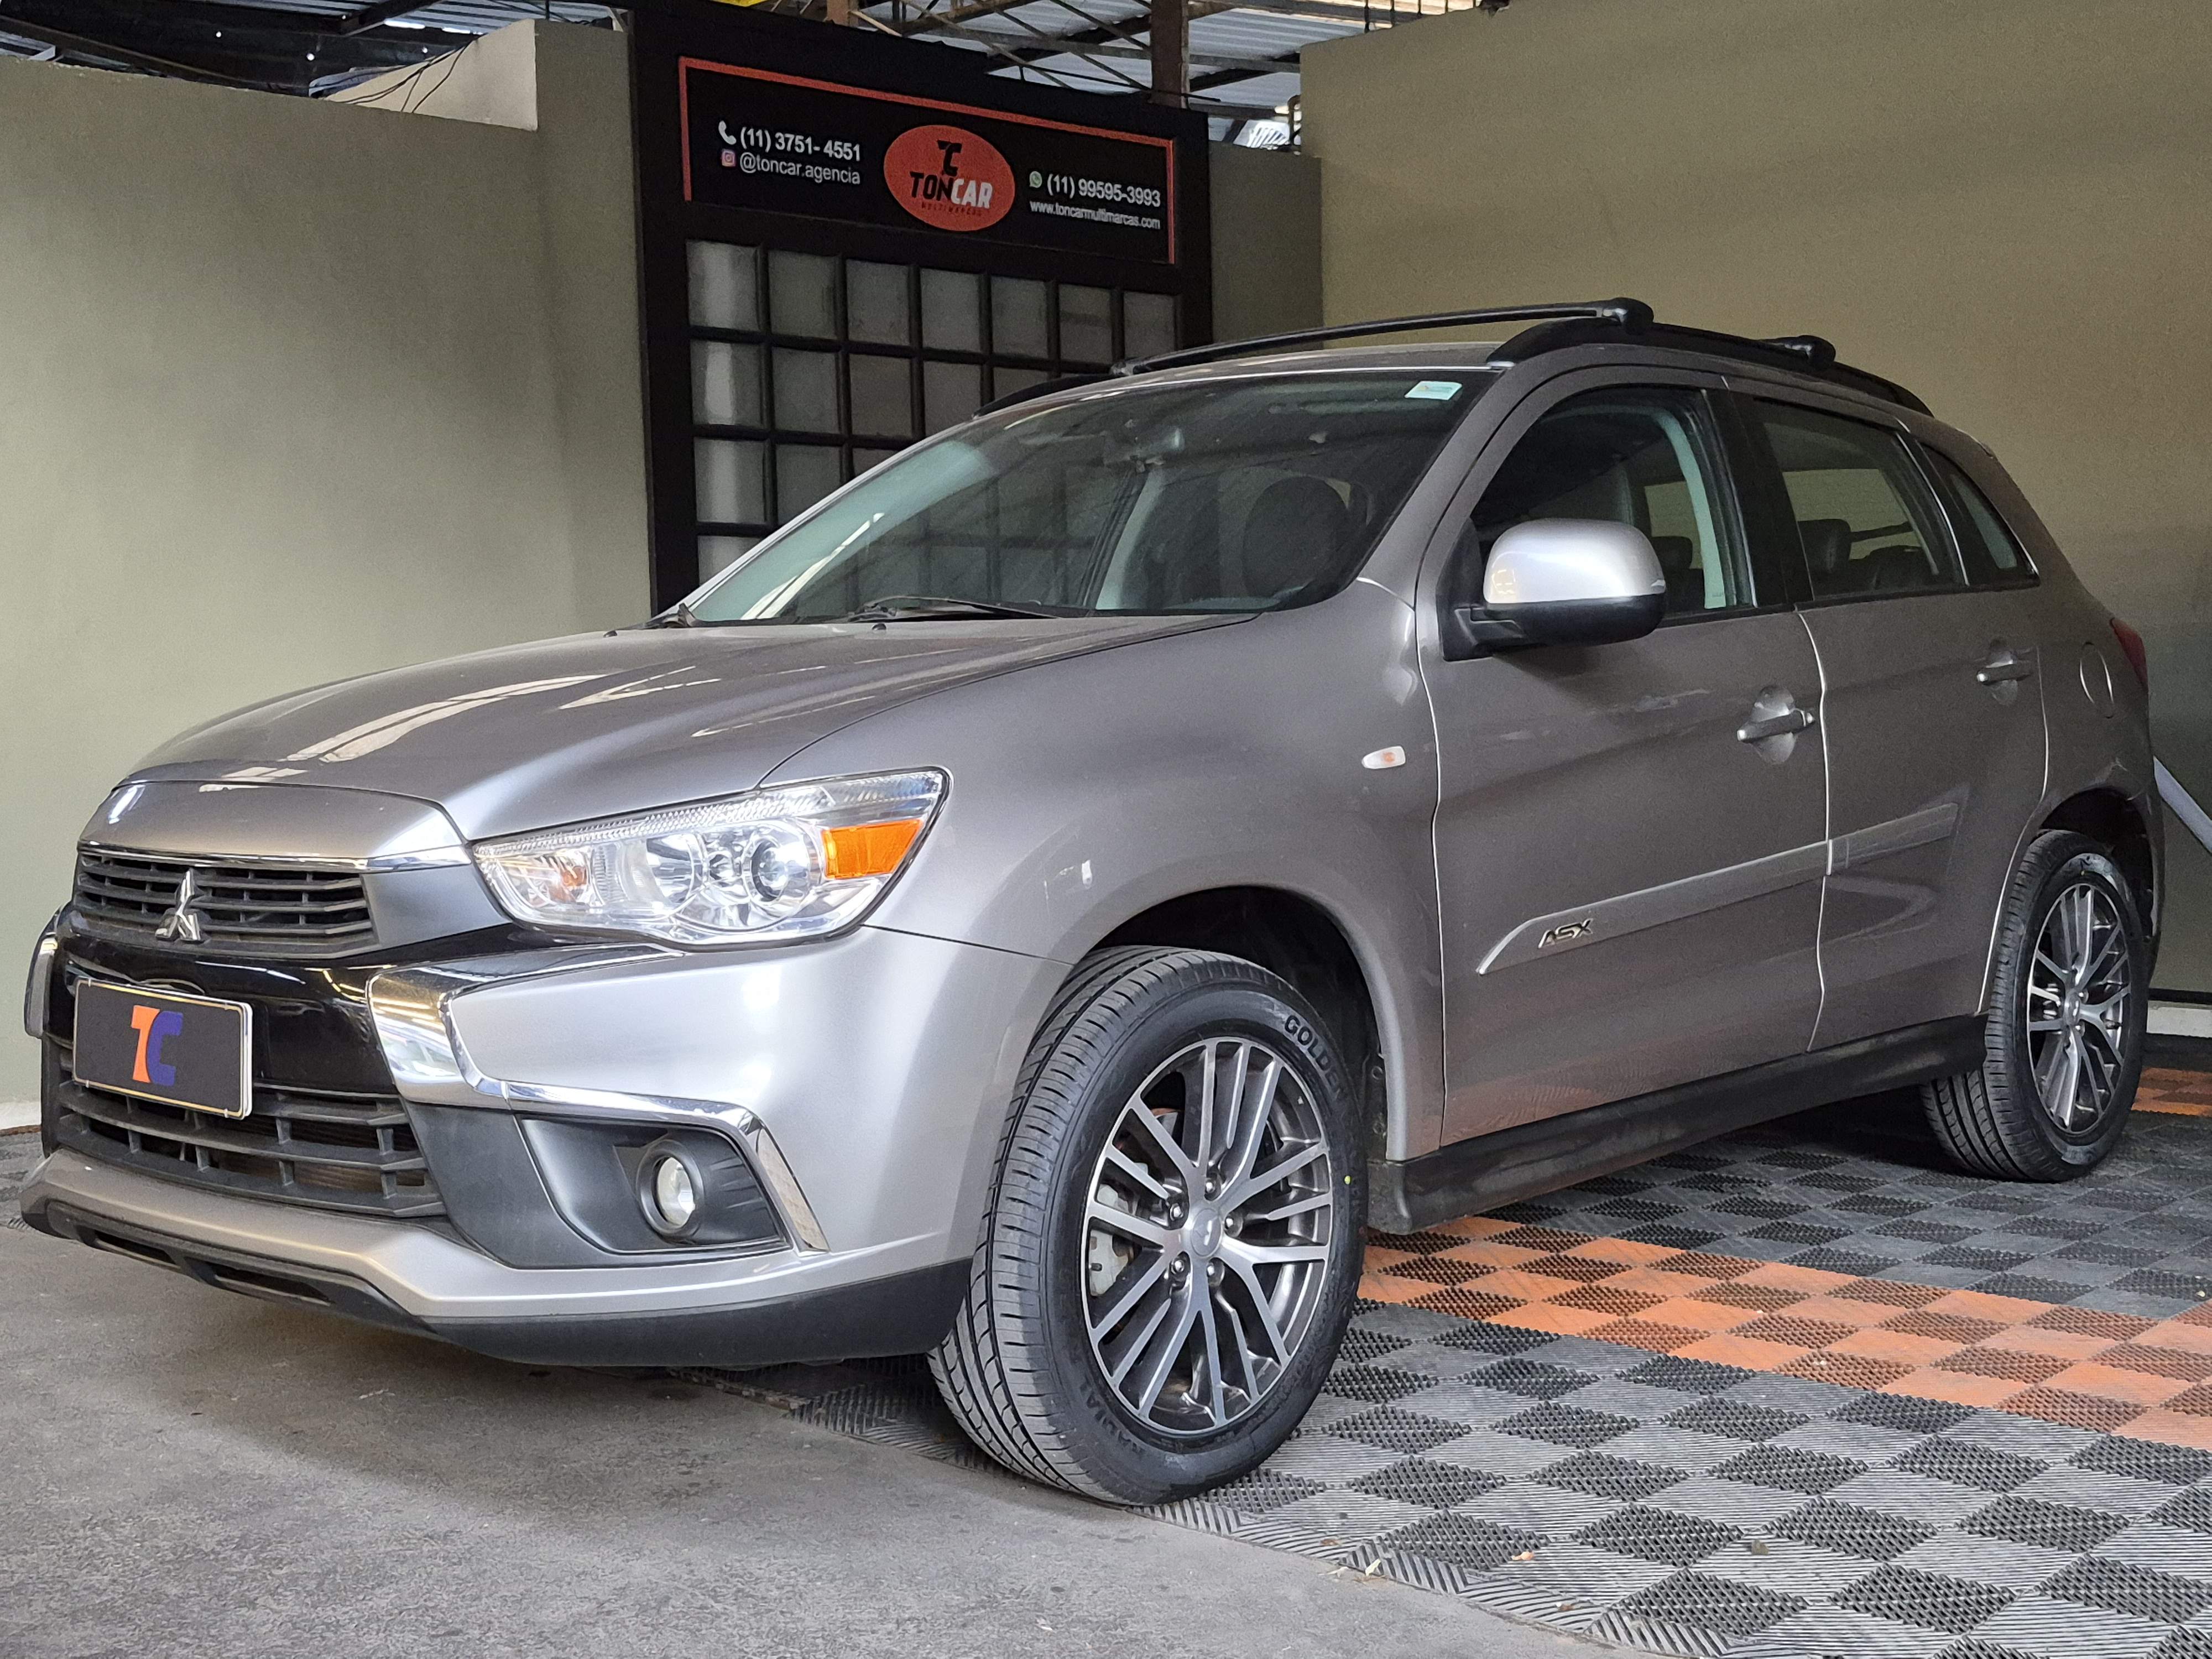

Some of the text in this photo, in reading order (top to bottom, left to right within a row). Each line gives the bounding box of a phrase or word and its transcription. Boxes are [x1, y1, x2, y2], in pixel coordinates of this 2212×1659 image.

[740, 126, 771, 153] (11)
[823, 139, 860, 161] 4551
[739, 152, 860, 185] @toncar.agencia
[909, 171, 993, 209] TONCAR
[1047, 173, 1161, 207] (11) 99595-3993
[1538, 917, 1594, 948] ASX
[130, 1004, 183, 1087] TC
